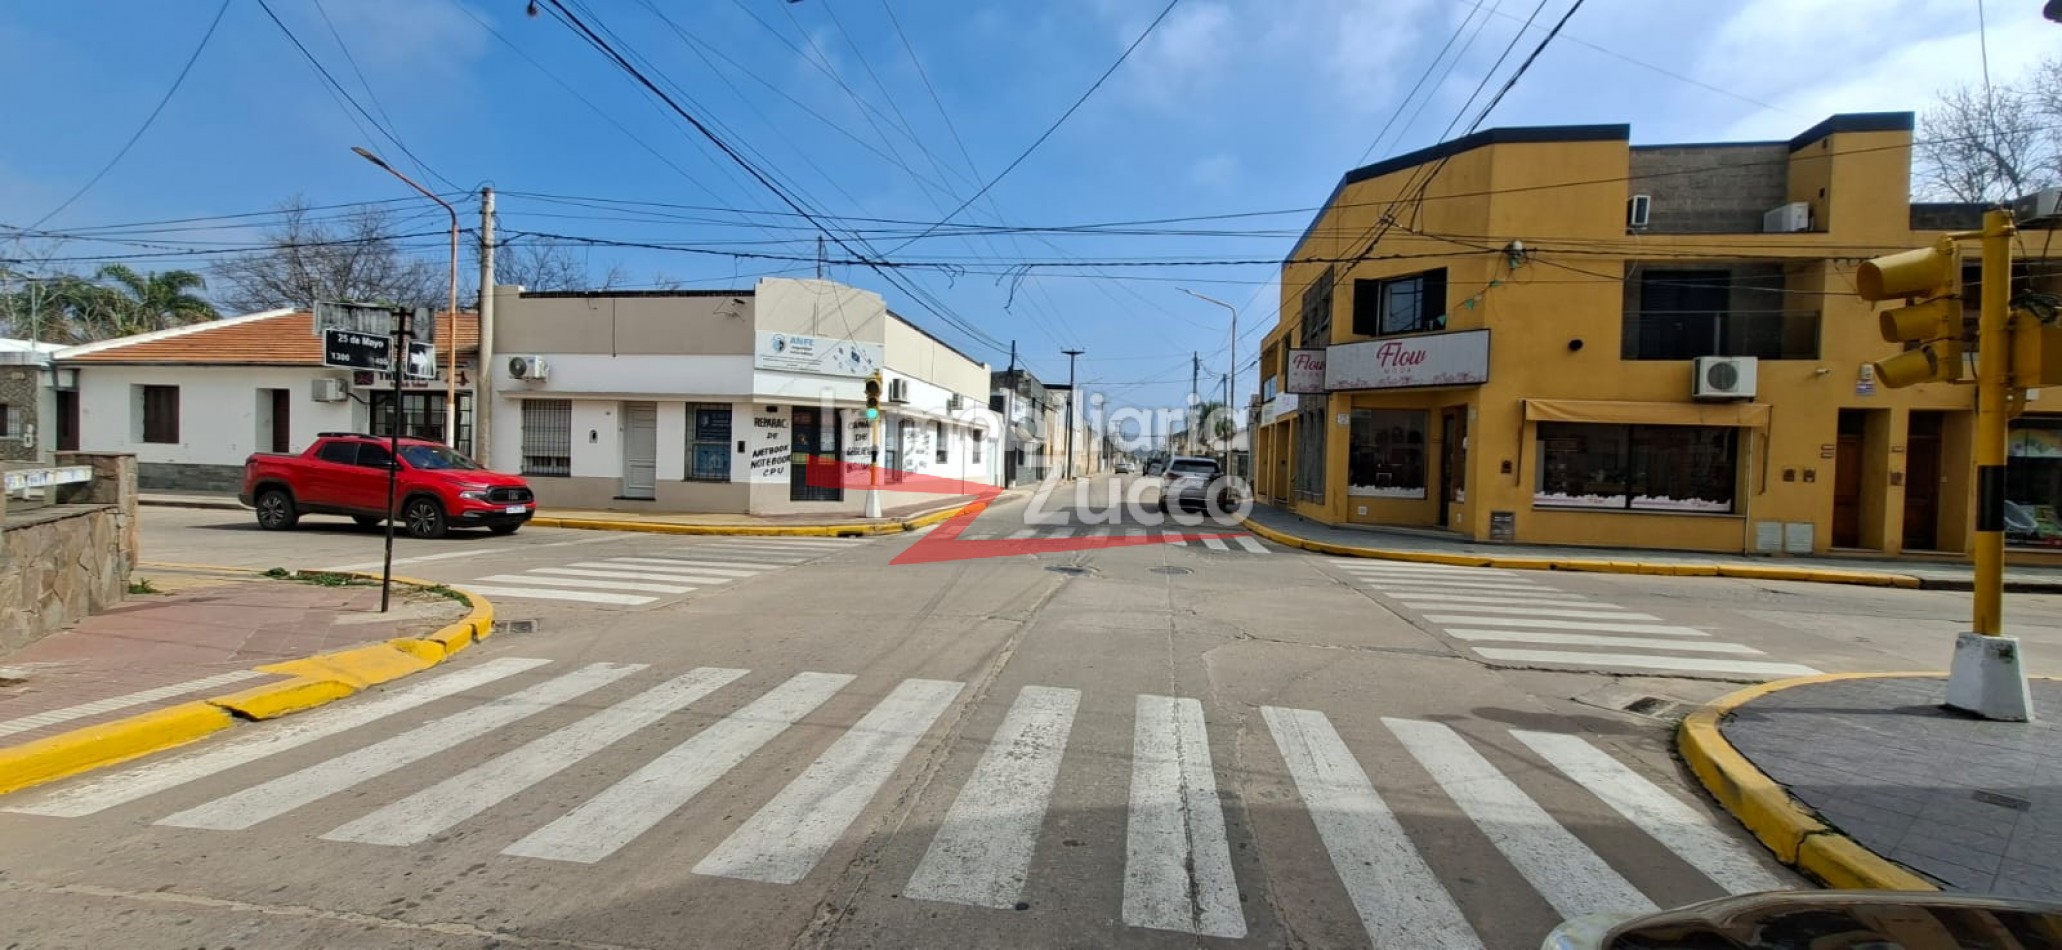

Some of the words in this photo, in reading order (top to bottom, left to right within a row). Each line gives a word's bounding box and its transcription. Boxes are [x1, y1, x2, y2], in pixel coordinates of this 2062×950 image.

[338, 333, 349, 343] 25
[350, 335, 360, 345] de
[361, 336, 384, 349] Mayo
[1376, 342, 1427, 368] Flow
[762, 467, 784, 477] CPU
